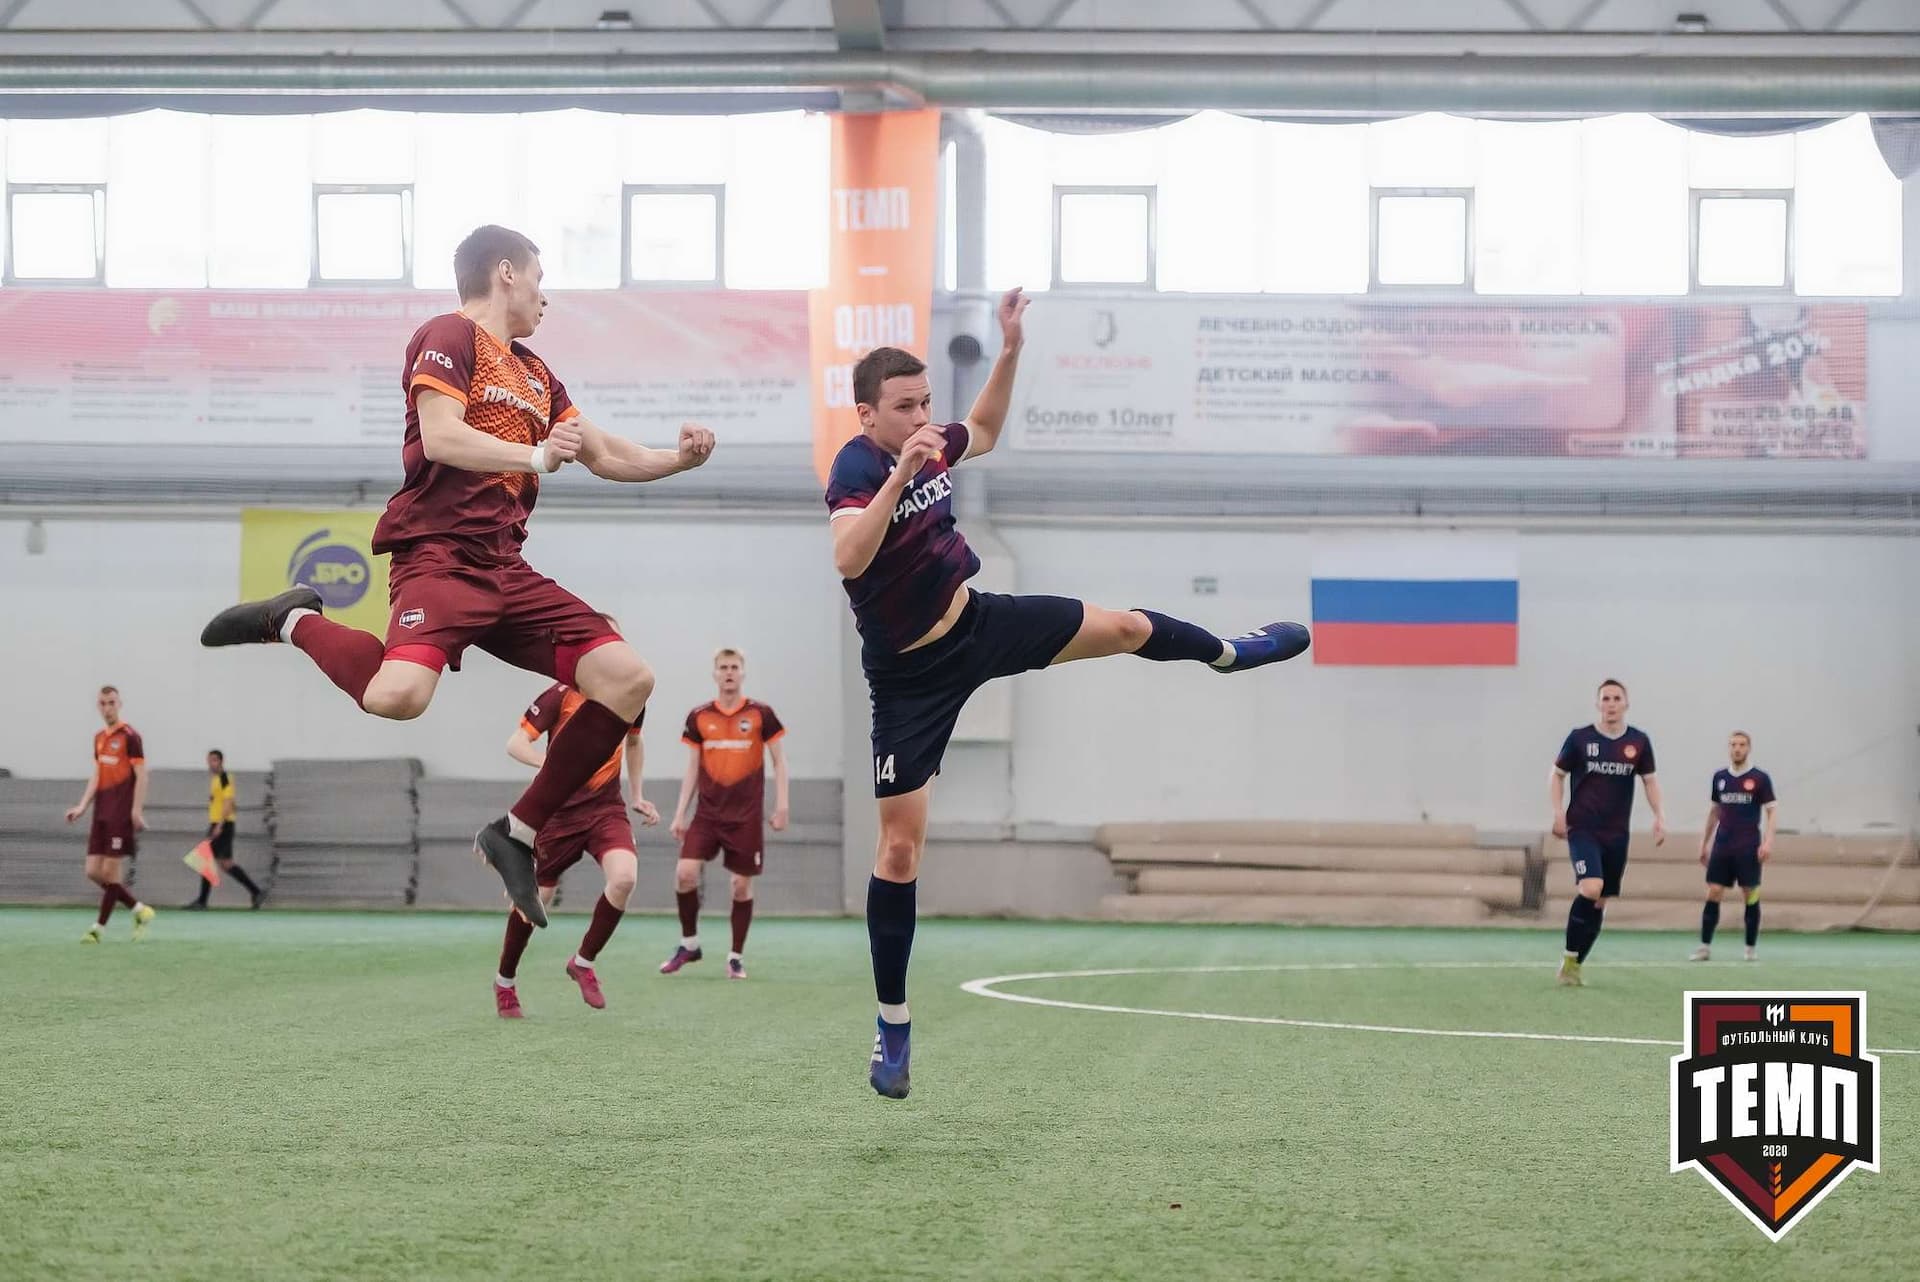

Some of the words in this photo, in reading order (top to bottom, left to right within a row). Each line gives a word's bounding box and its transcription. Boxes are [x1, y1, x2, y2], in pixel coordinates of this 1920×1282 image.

[833, 187, 909, 231] ТЕМП
[834, 304, 914, 350] ОДНА
[1026, 407, 1098, 427] более
[1586, 742, 1600, 757] 15
[876, 753, 896, 785] 14
[1587, 760, 1634, 776] РАССВЕТ
